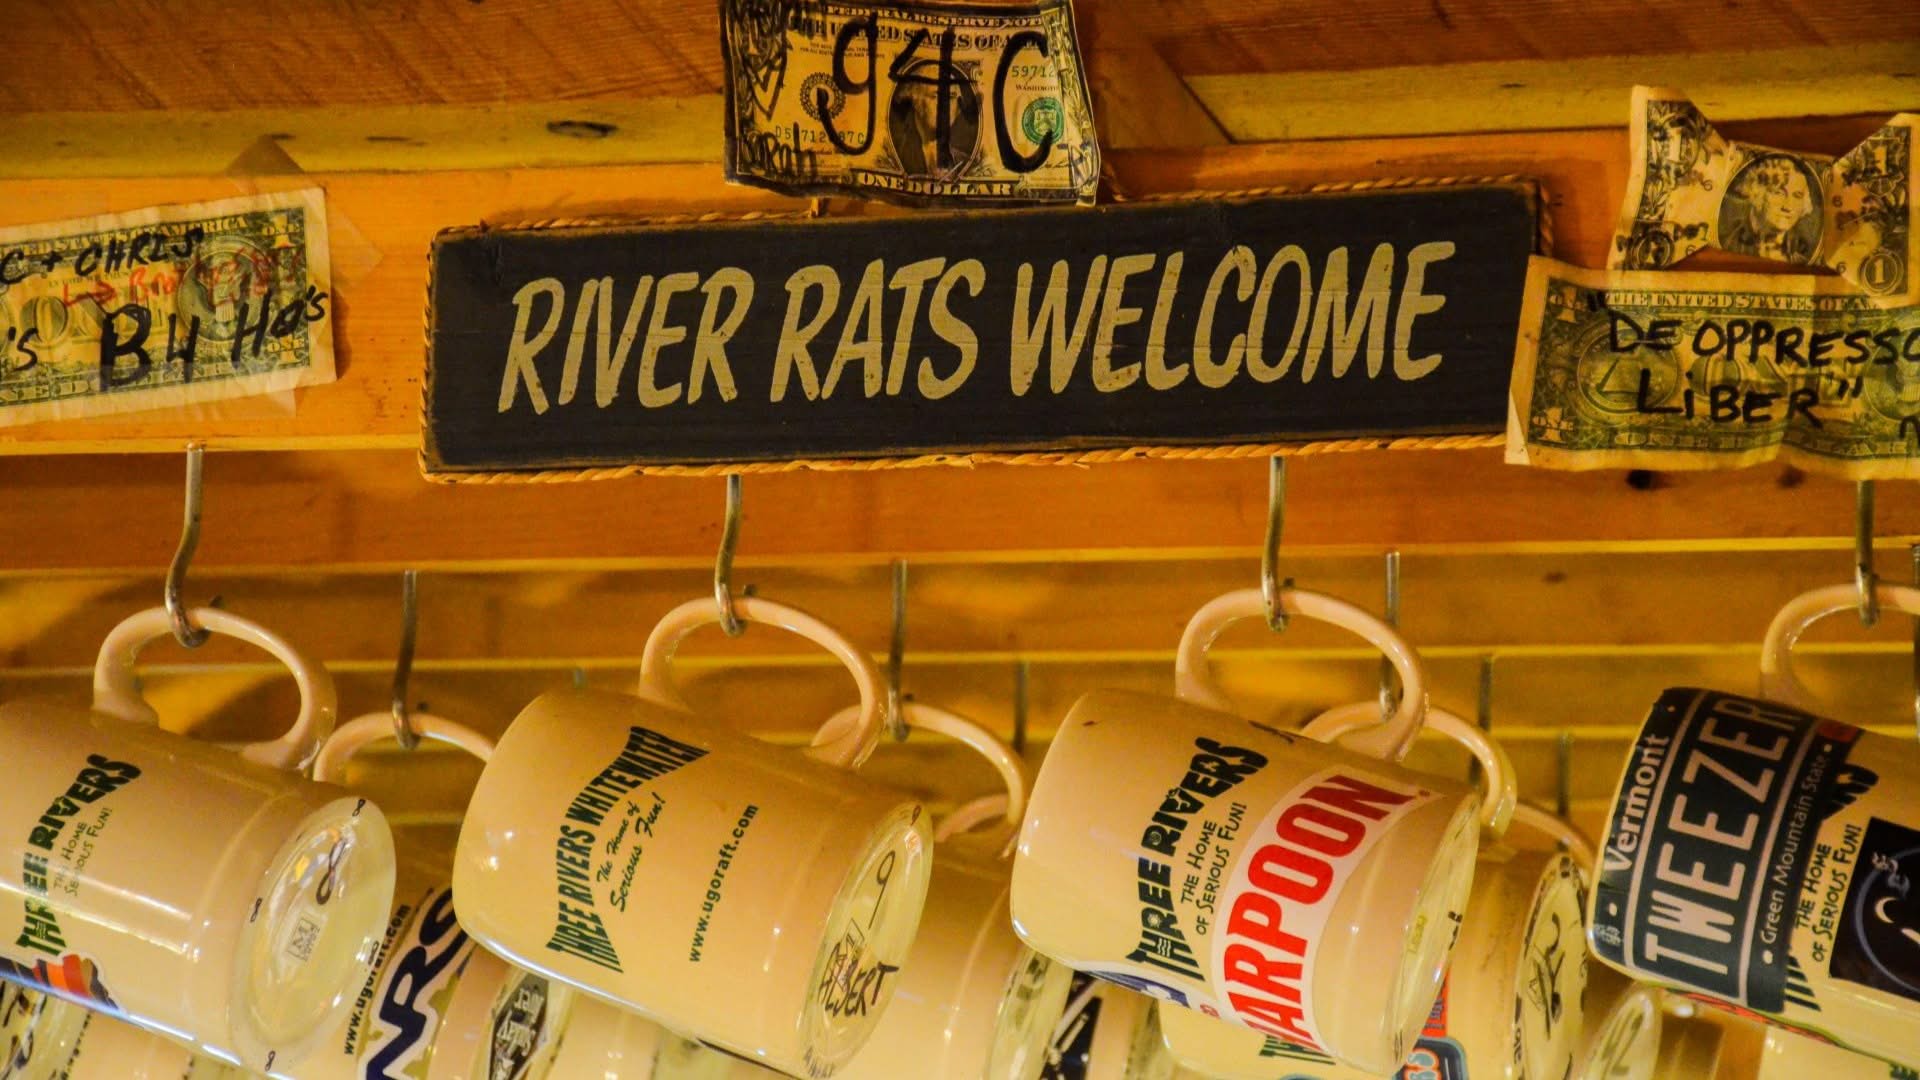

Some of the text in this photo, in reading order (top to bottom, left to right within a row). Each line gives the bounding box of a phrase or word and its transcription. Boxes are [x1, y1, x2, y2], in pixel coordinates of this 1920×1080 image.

[857, 172, 1012, 197] ONE DOLLAR
[498, 241, 1456, 415] RIVER RATS WELCOME
[28, 754, 142, 851] RIVERS
[60, 821, 87, 861] HOME
[86, 806, 113, 838] FUN!
[546, 726, 710, 973] THREE RIVERS WHITEWATER
[596, 801, 641, 884] The Home of
[610, 791, 667, 912] Serious Fun!
[1603, 733, 1670, 871] Vermont
[1645, 700, 1803, 975] TWEEZER
[1772, 795, 1812, 886] Mountain
[689, 804, 759, 962] www.ugoraft.com
[1126, 737, 1268, 982] THREE RIVERS
[1181, 820, 1217, 904] THE HOME
[1196, 801, 1247, 936] OF SERIOUS FUN!
[1796, 843, 1831, 929] THE HOME
[1811, 823, 1862, 963] OF SERIOUS FUN!
[1761, 889, 1785, 945] Green
